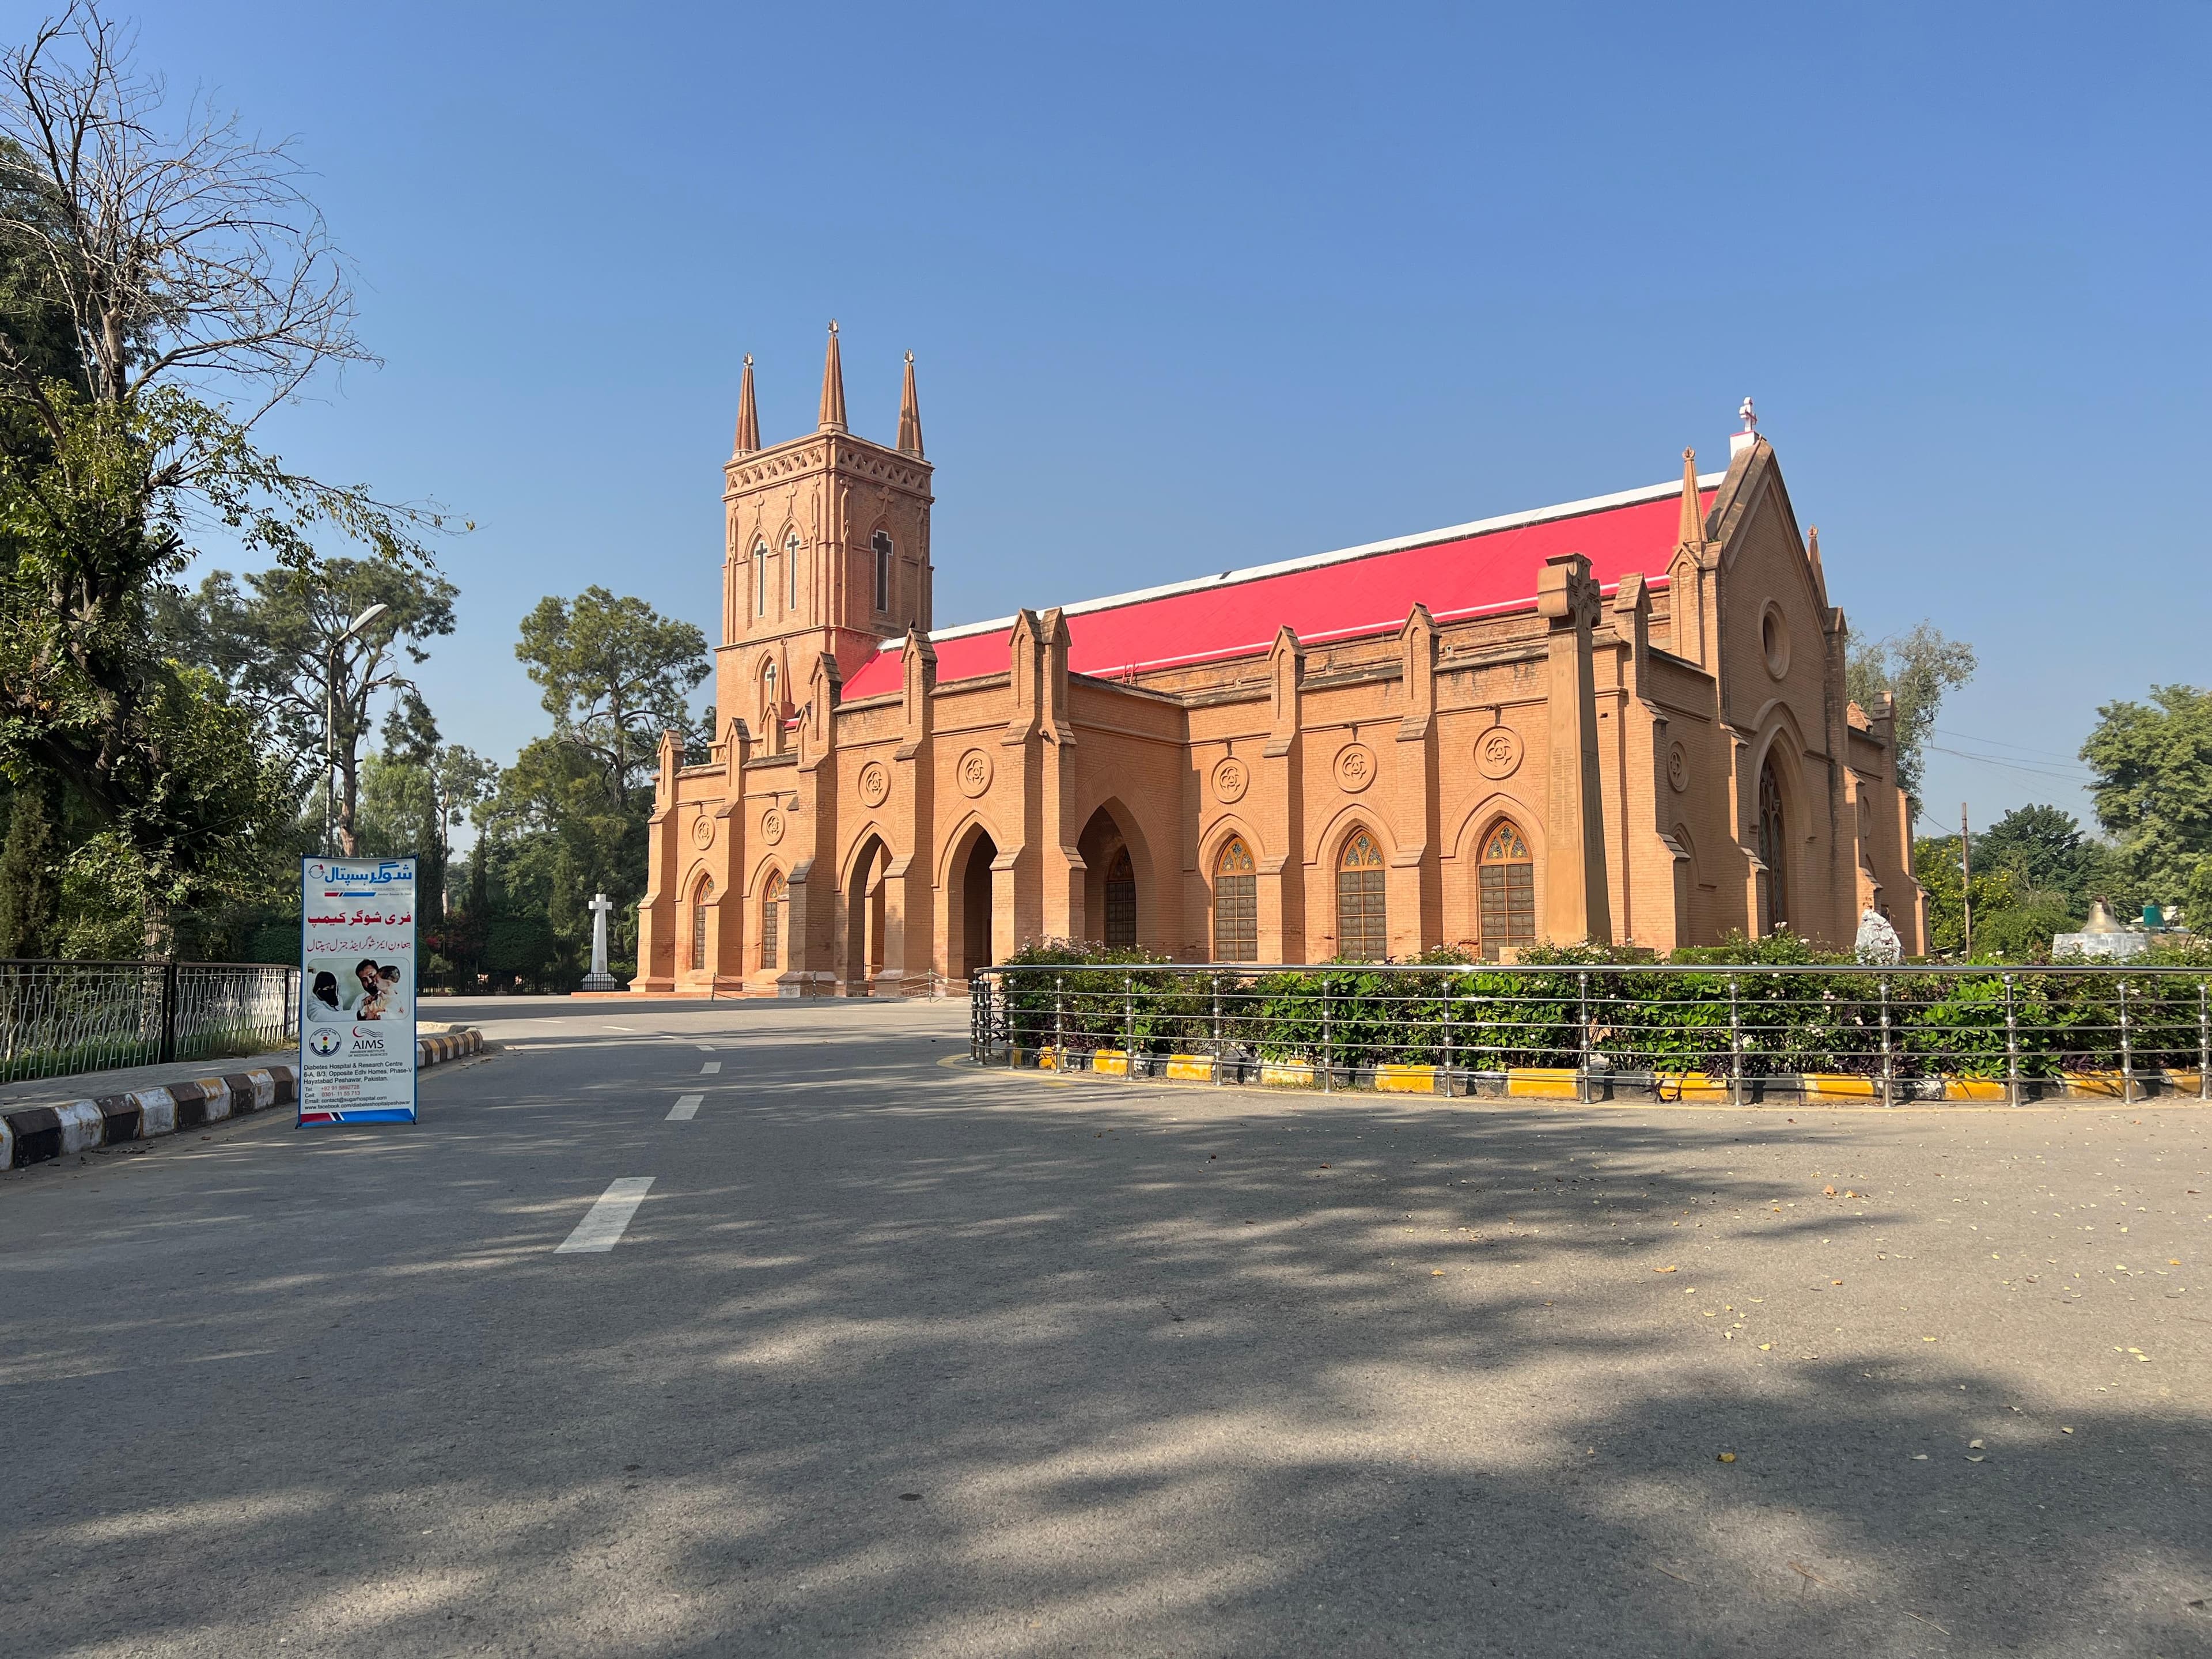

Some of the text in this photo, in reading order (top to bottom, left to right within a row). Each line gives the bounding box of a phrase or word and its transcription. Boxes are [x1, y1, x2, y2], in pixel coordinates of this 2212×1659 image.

[325, 862, 412, 886] شوگر ہسپتال
[308, 910, 411, 928] فری شوگر کیمپ
[329, 938, 347, 953] جنرل
[361, 935, 376, 949] شوگر
[352, 1039, 384, 1050] AIMS
[304, 1078, 333, 1086] Hayatabad
